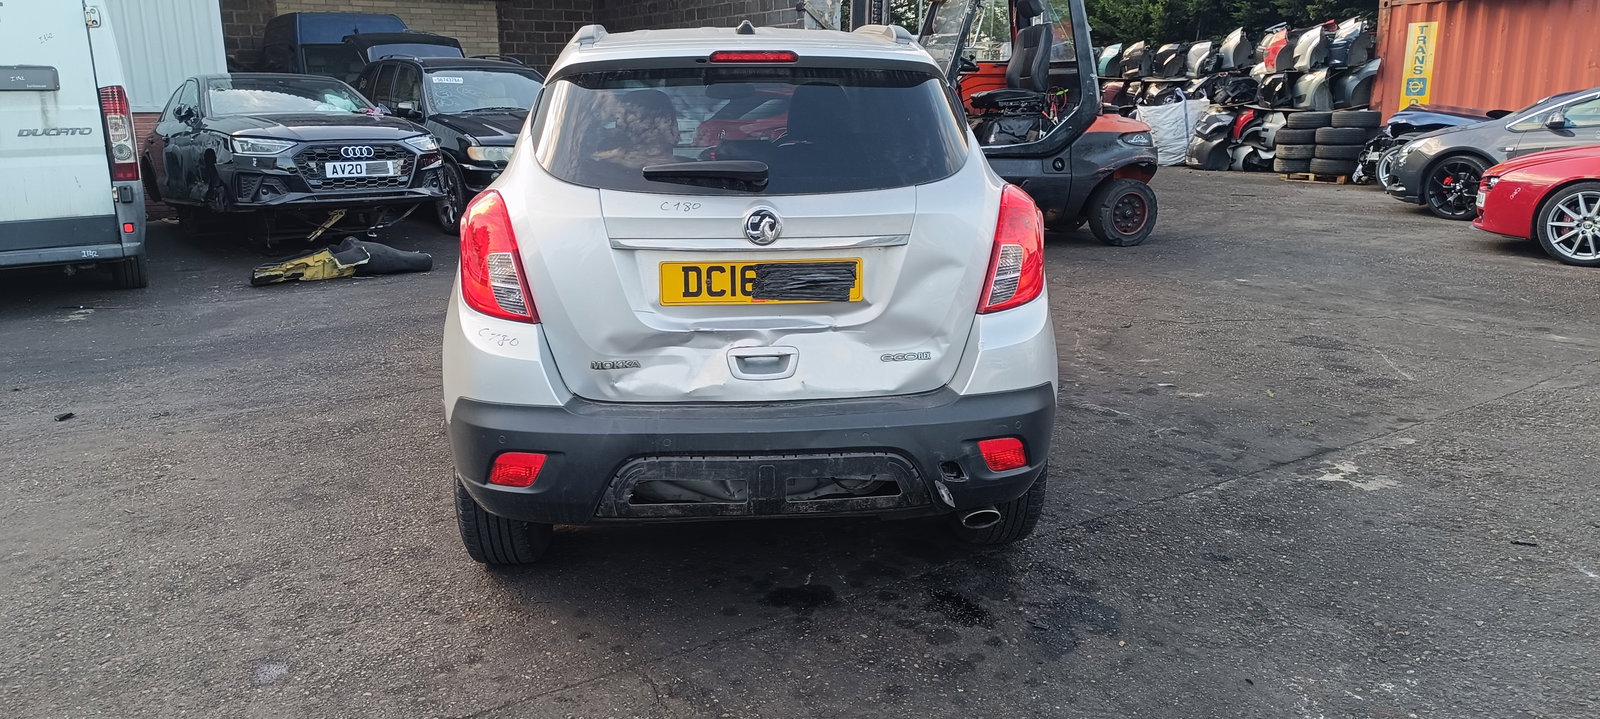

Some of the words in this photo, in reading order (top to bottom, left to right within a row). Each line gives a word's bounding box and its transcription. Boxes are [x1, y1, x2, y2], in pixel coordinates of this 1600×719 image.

[1412, 25, 1428, 75] TRANS
[17, 127, 92, 137] DUCATO
[332, 164, 362, 175] AV20
[590, 360, 641, 370] MOKKA
